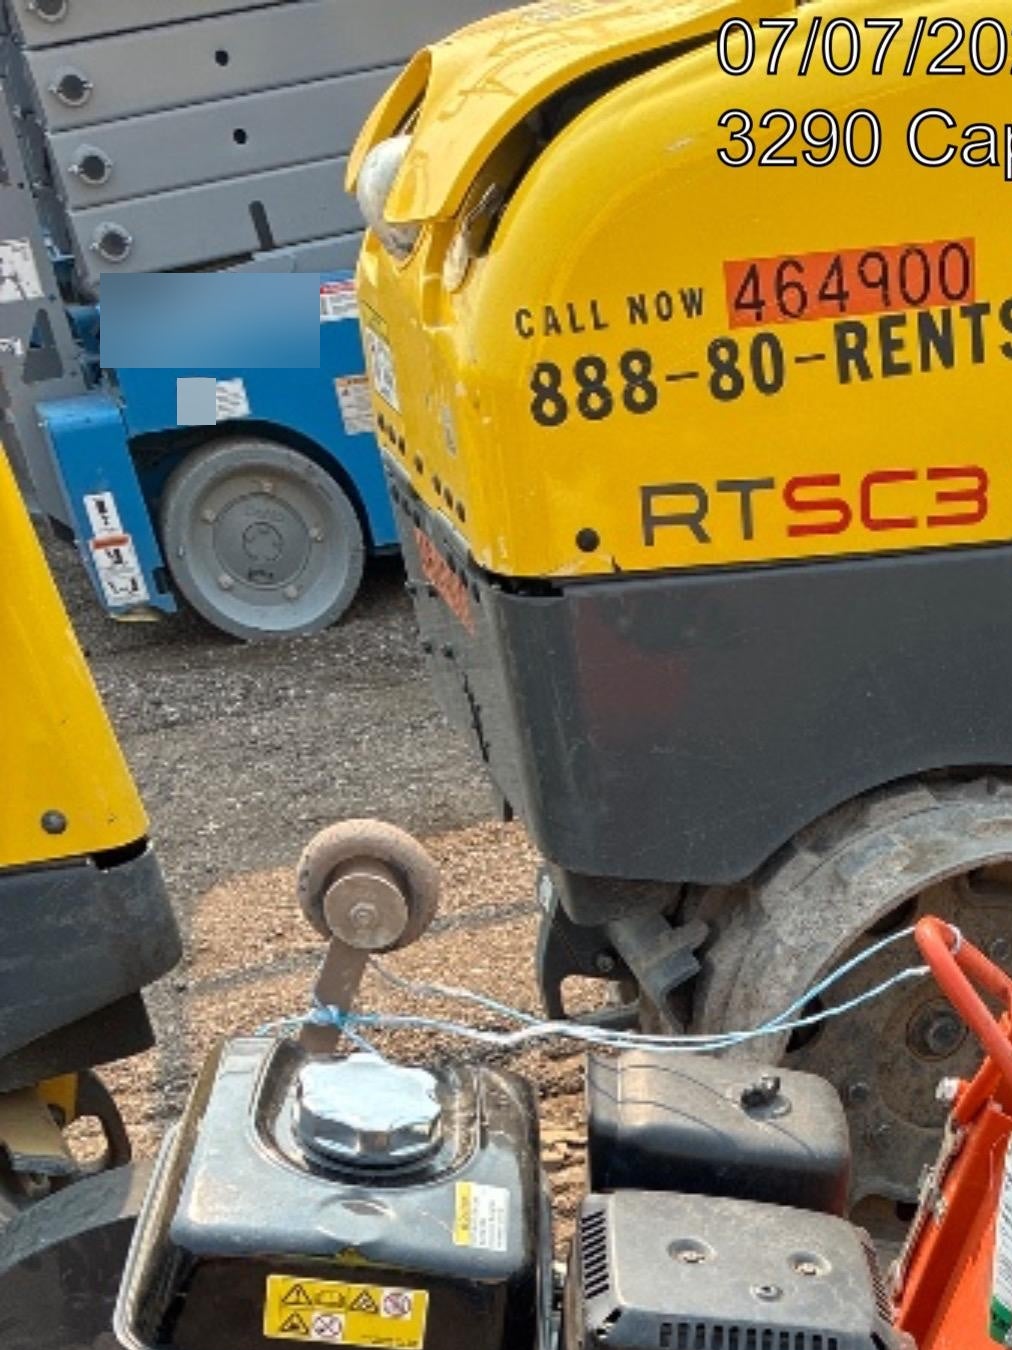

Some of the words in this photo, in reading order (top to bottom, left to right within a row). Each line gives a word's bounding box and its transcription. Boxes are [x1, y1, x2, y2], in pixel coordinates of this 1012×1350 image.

[515, 298, 609, 340] CALL
[627, 287, 705, 325] NOW
[734, 242, 971, 322] 464900
